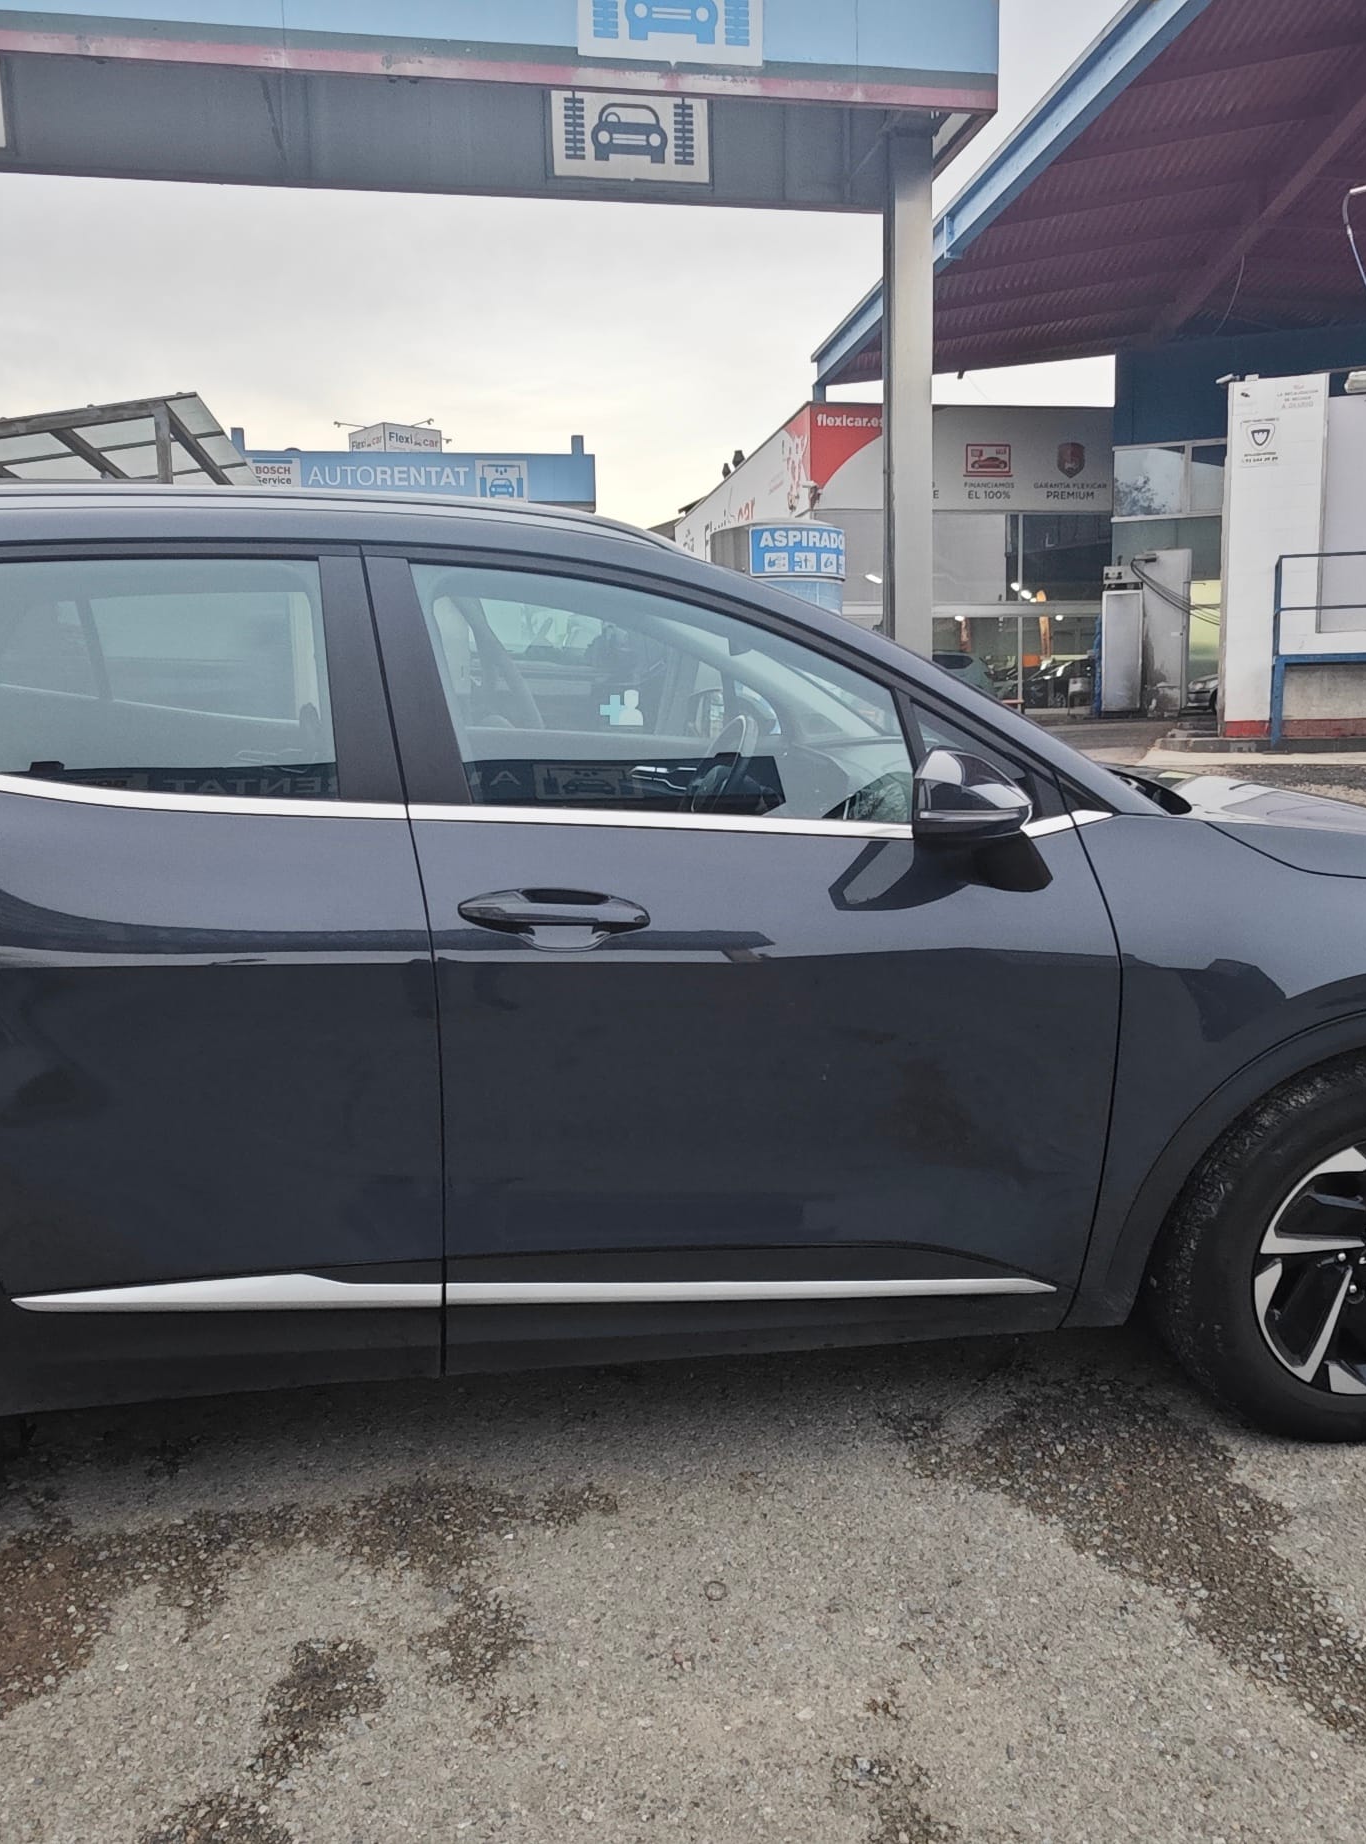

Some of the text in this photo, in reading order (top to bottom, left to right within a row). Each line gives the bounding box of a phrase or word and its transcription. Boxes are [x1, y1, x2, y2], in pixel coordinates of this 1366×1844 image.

[255, 465, 291, 475] BOSCH
[308, 465, 469, 487] AUTORENTAT
[968, 490, 1011, 500] EL 100%
[1046, 491, 1095, 500] PREMIUM
